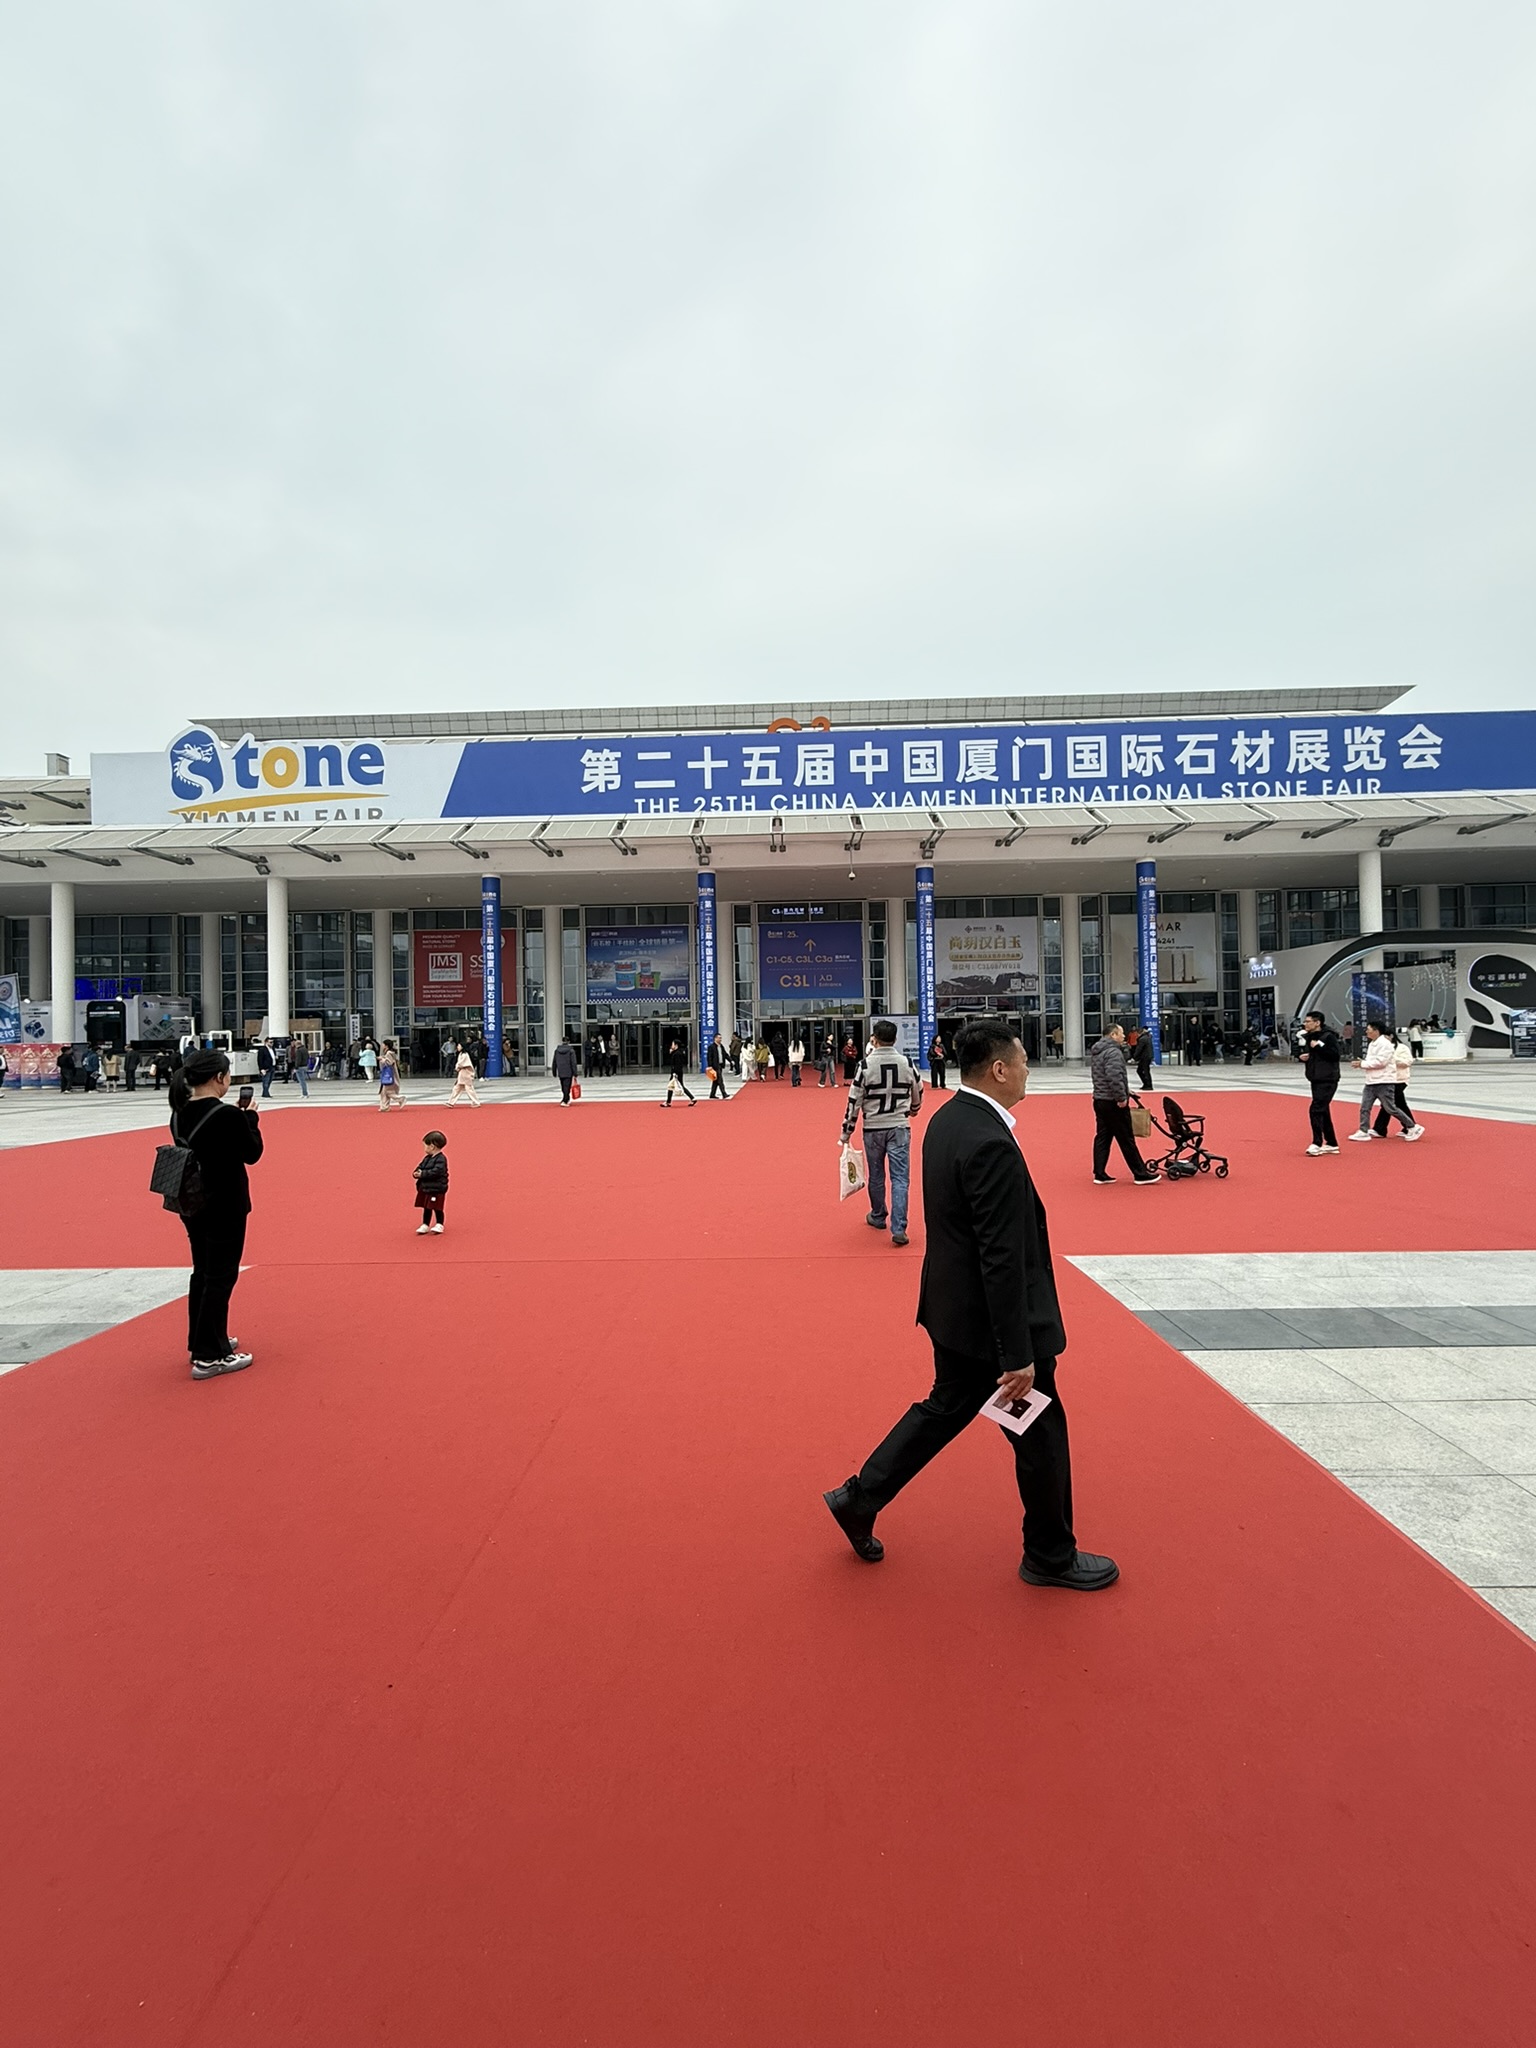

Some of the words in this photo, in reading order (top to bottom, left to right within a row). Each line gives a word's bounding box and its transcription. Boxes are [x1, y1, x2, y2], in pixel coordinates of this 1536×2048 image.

[170, 729, 385, 801] Stone
[580, 723, 1443, 794] 第二十五届中国厦门国际石材展览会
[634, 798, 680, 814] THE
[693, 795, 756, 813] 25TH
[770, 793, 858, 811] CHINA
[871, 788, 977, 808] XIAMEN
[991, 783, 1208, 805] INTERNATIONAL
[1221, 780, 1308, 799] STONE
[1322, 778, 1382, 796] FAIR
[432, 955, 457, 968] JMS
[780, 975, 810, 988] C3L
[819, 974, 833, 982] 入口
